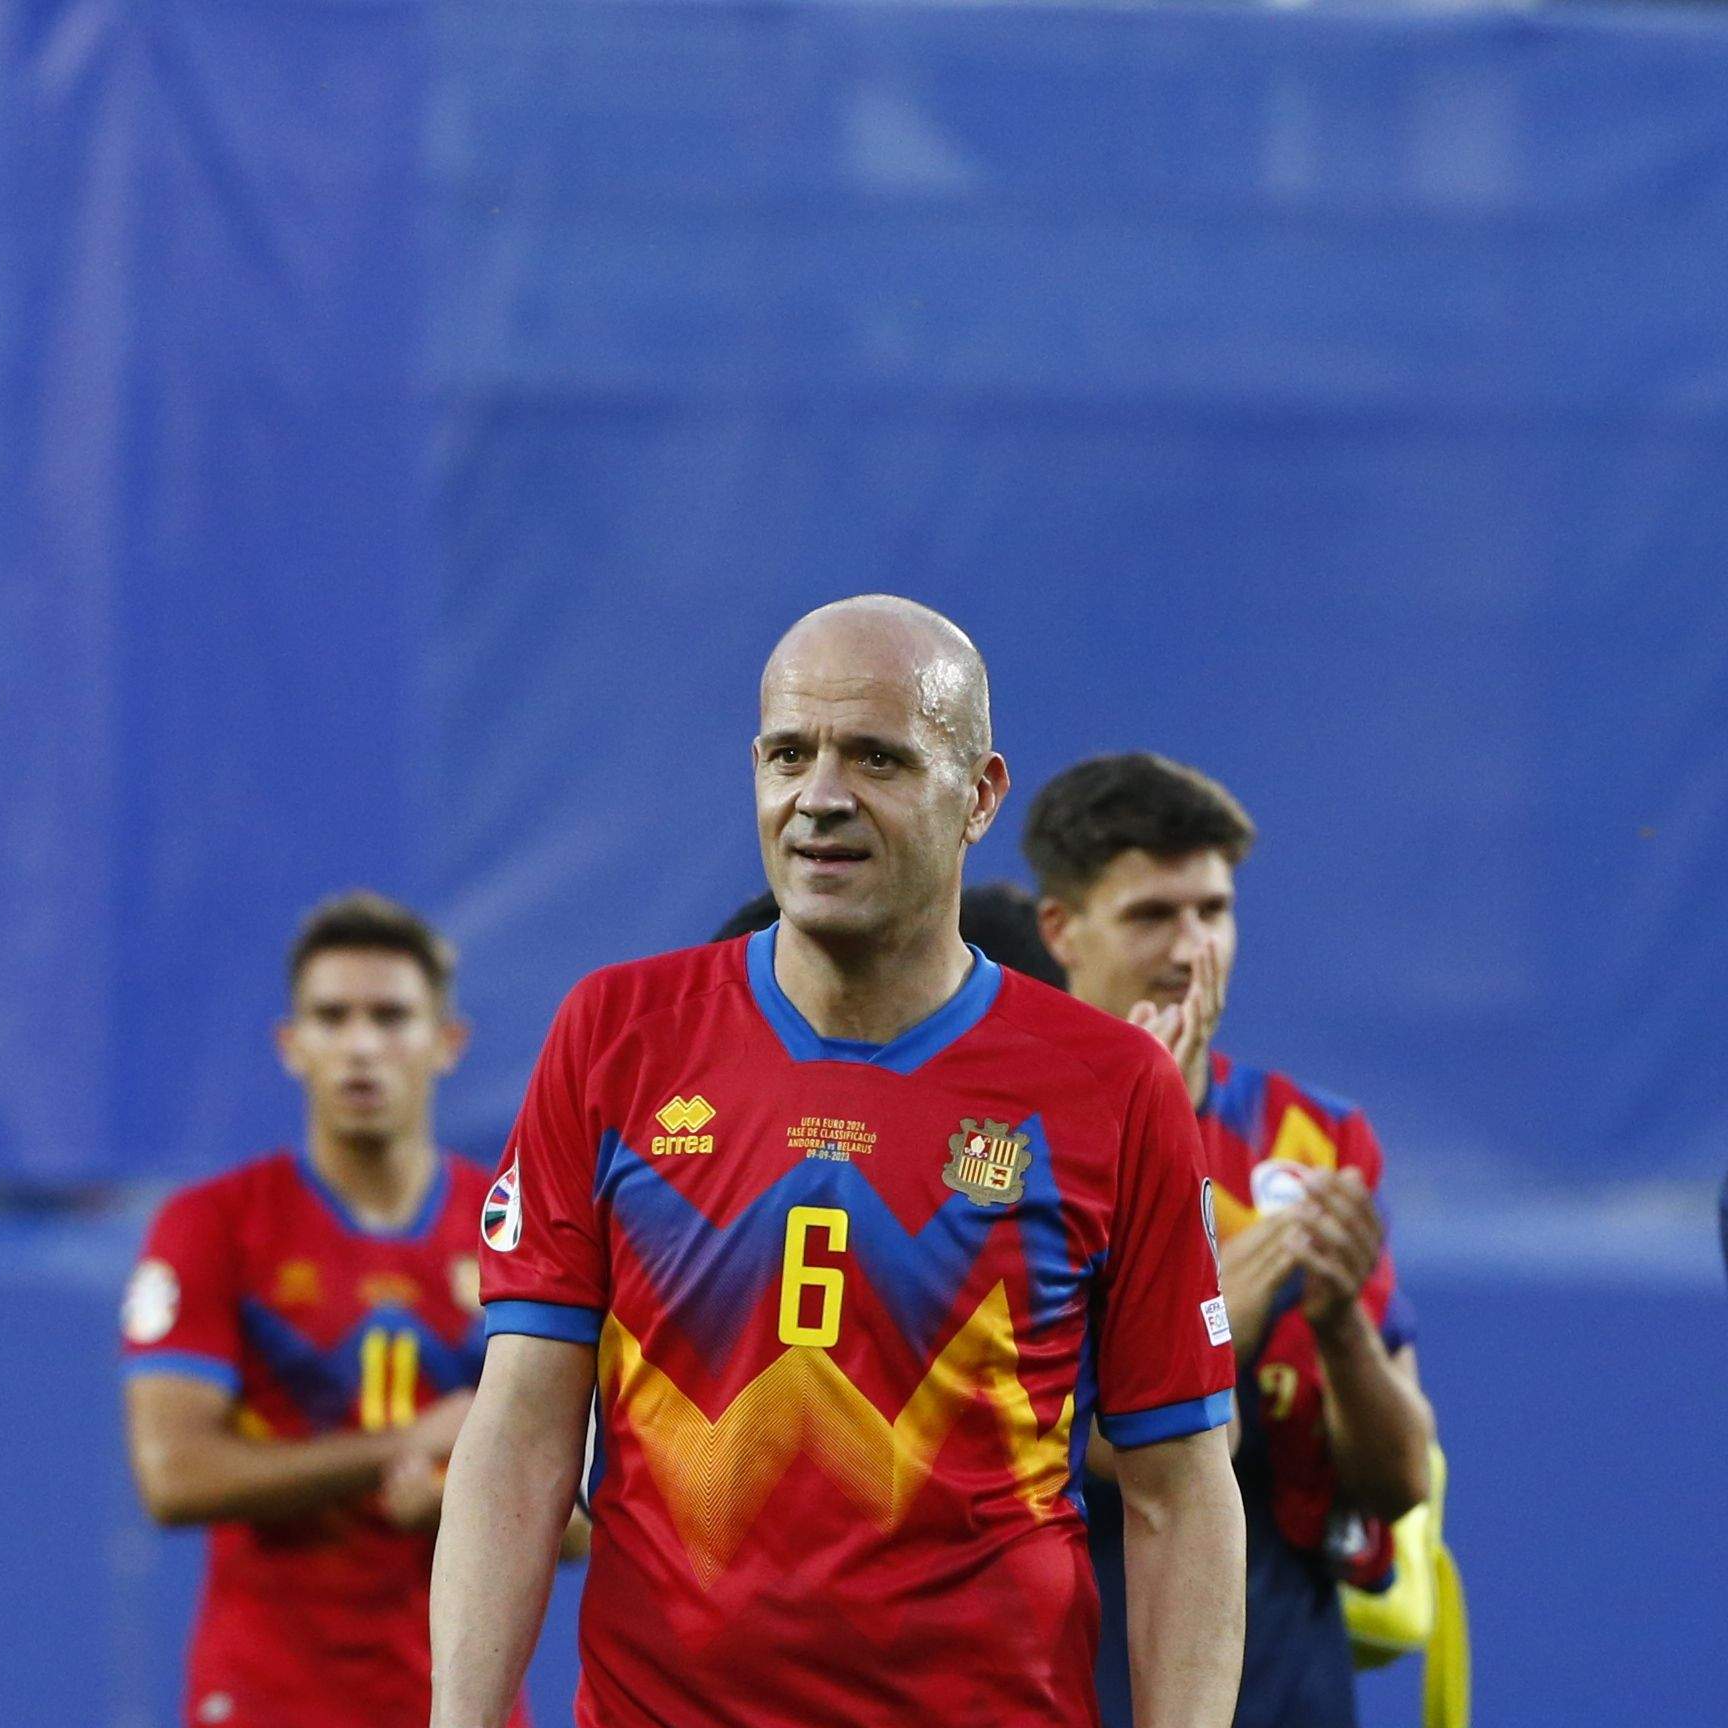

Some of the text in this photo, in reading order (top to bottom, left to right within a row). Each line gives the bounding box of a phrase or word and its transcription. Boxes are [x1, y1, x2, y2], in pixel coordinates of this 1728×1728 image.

[801, 1117, 866, 1131] UEFA EURO 2024
[787, 1127, 877, 1143] FASE DE CLASSIFICACIÓ
[787, 1138, 825, 1149] ANDORRA
[837, 1141, 872, 1154] BELARUS
[778, 1206, 848, 1347] 6
